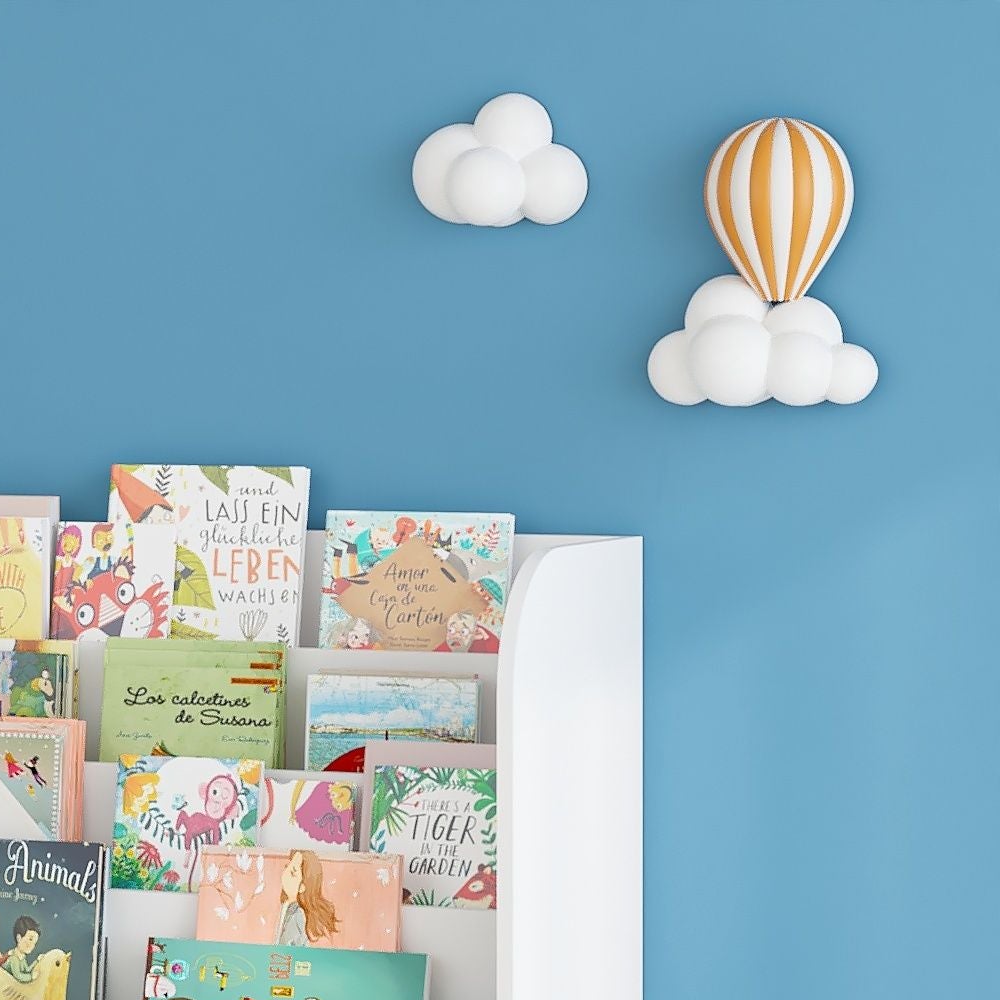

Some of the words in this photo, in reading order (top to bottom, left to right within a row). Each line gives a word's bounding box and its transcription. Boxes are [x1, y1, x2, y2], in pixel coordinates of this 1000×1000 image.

[235, 481, 278, 496] und
[206, 498, 248, 524] LASS
[213, 547, 301, 584] LEBEN
[383, 562, 429, 582] Amor
[123, 687, 167, 706] Los
[171, 690, 252, 708] calcetines
[174, 710, 195, 724] de
[200, 708, 272, 728] Susana
[462, 801, 472, 812] A
[409, 813, 477, 845] TIGER
[420, 842, 431, 855] IN
[437, 843, 460, 857] THE
[3, 840, 98, 904] Animals
[409, 856, 473, 877] GARDEN
